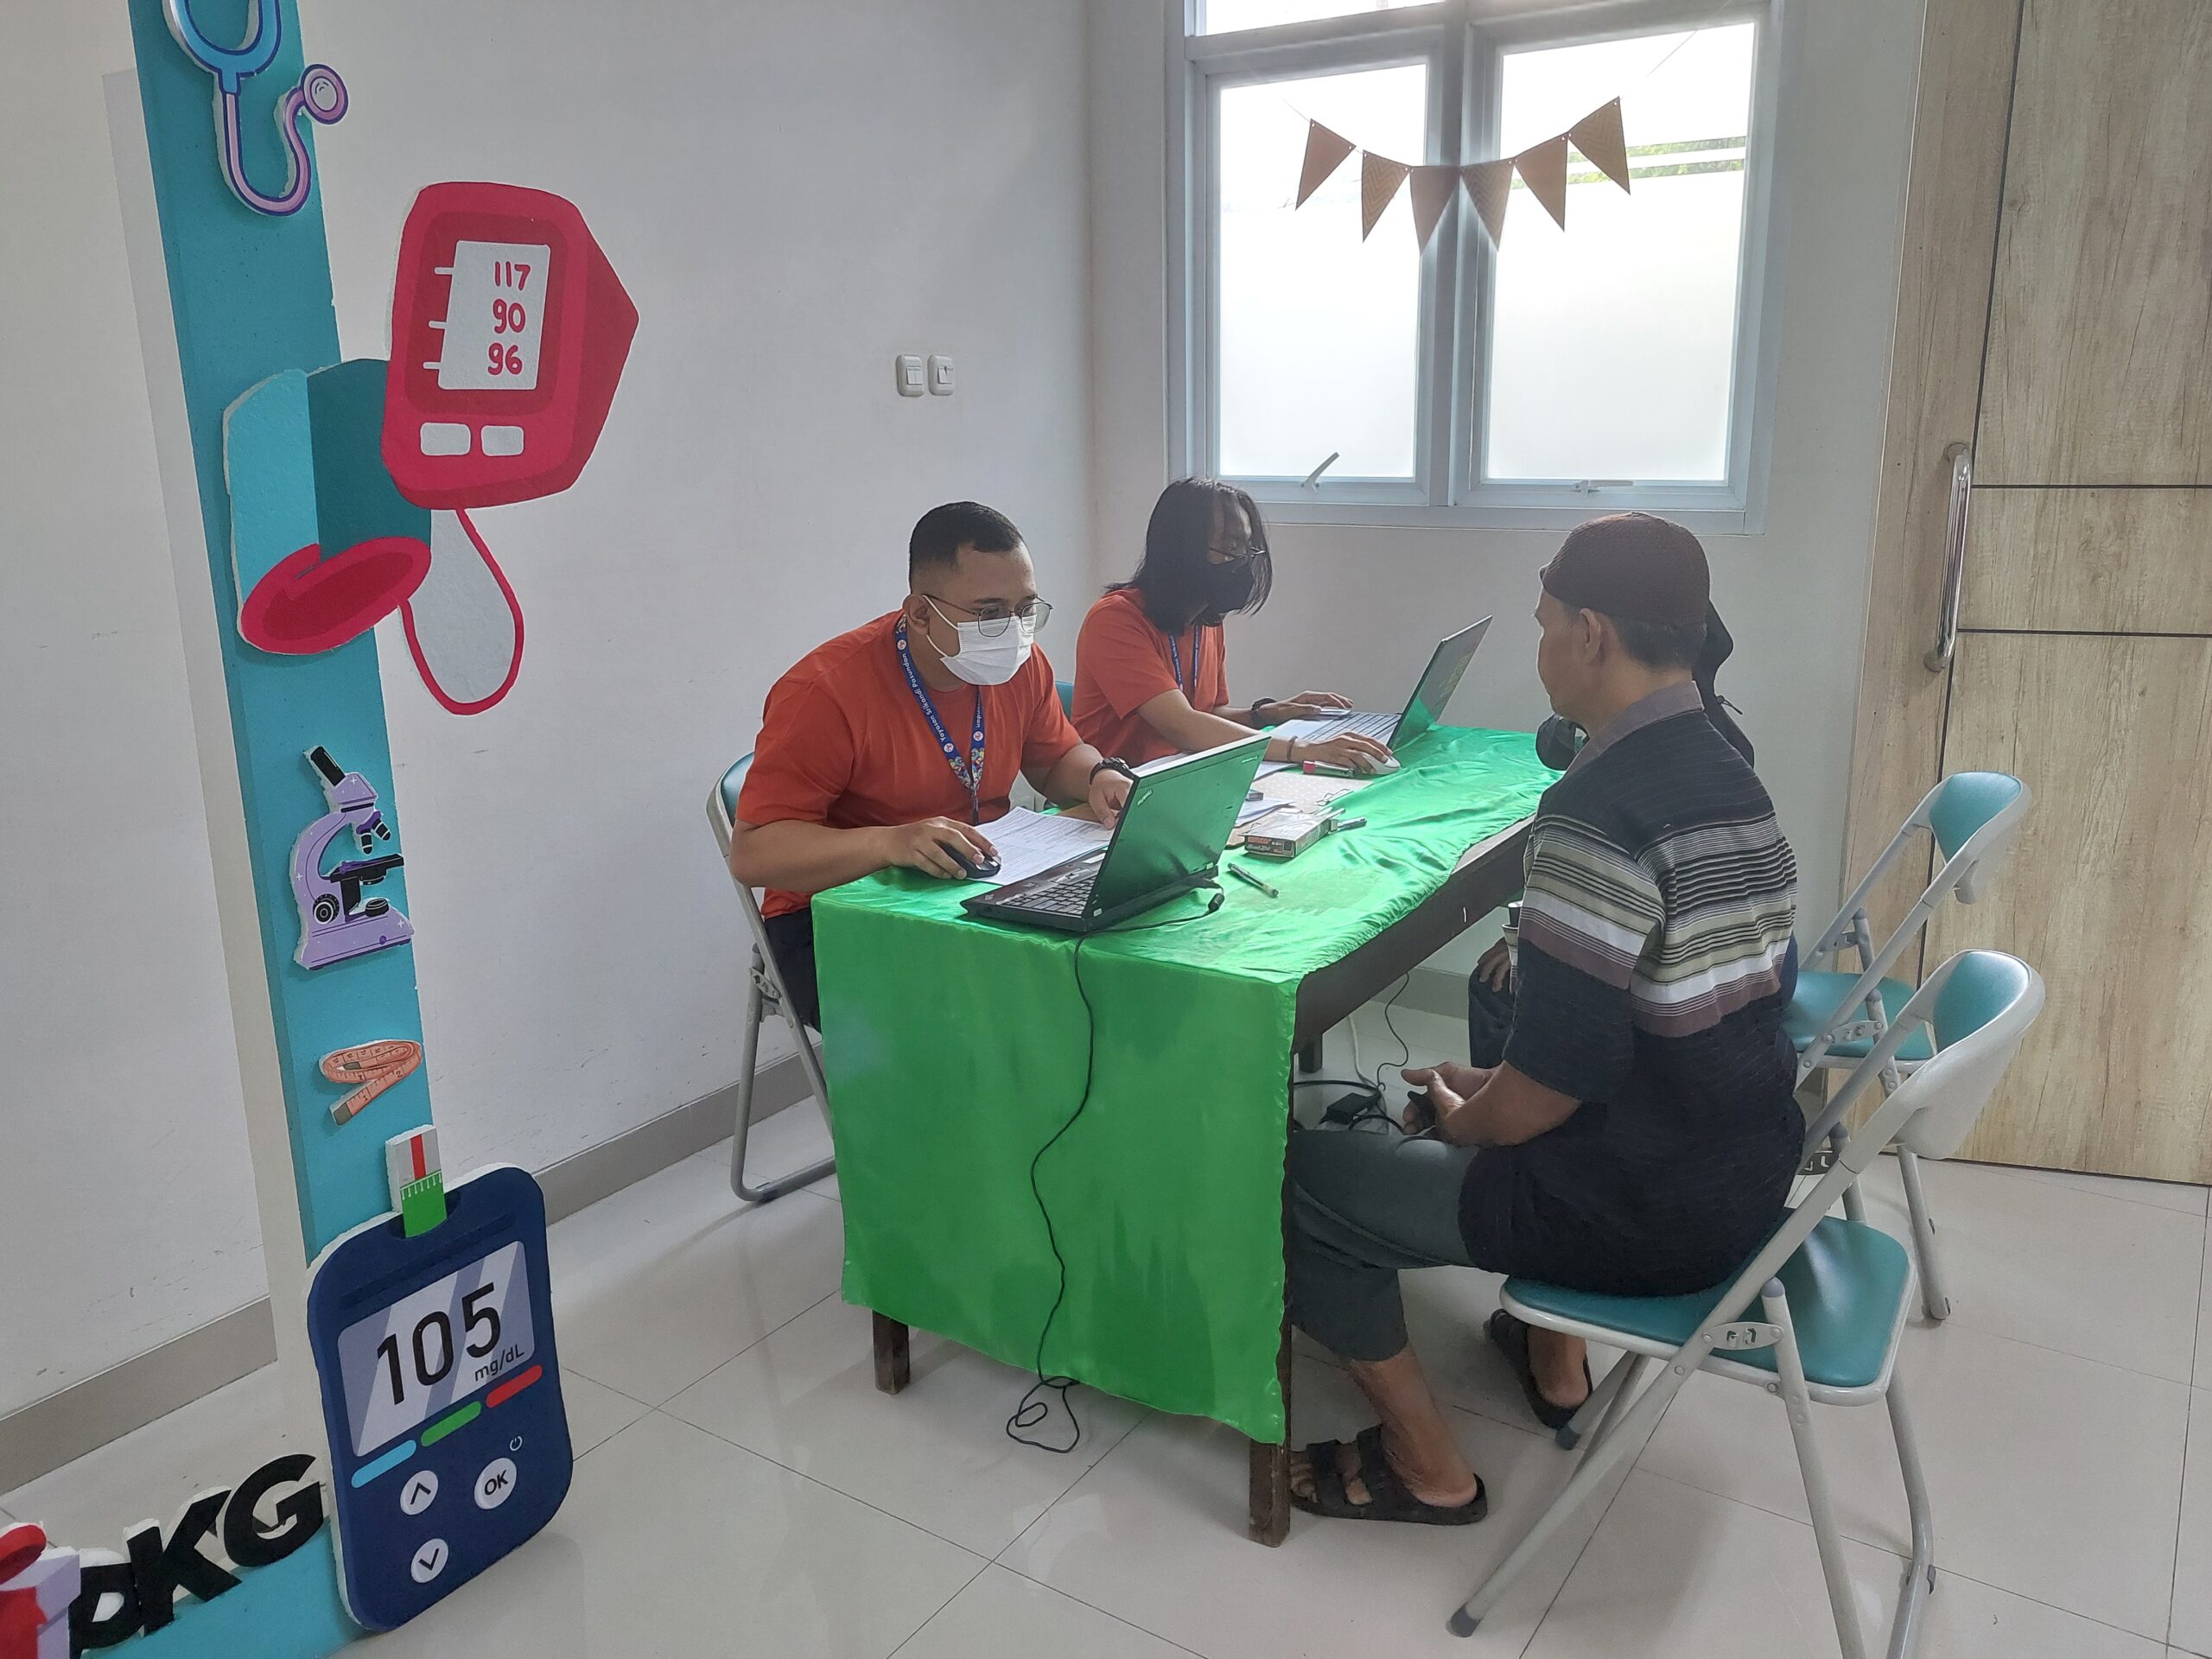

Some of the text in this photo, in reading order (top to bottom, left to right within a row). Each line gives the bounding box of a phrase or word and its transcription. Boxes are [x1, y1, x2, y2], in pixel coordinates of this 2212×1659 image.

[493, 261, 531, 290] 117
[493, 298, 526, 334] 90
[487, 342, 523, 375] 96
[902, 653, 946, 742] Yayasan Srikandi Pasundan
[377, 1281, 501, 1406] 105
[474, 1344, 525, 1382] mg/dL
[485, 1469, 508, 1496] OK
